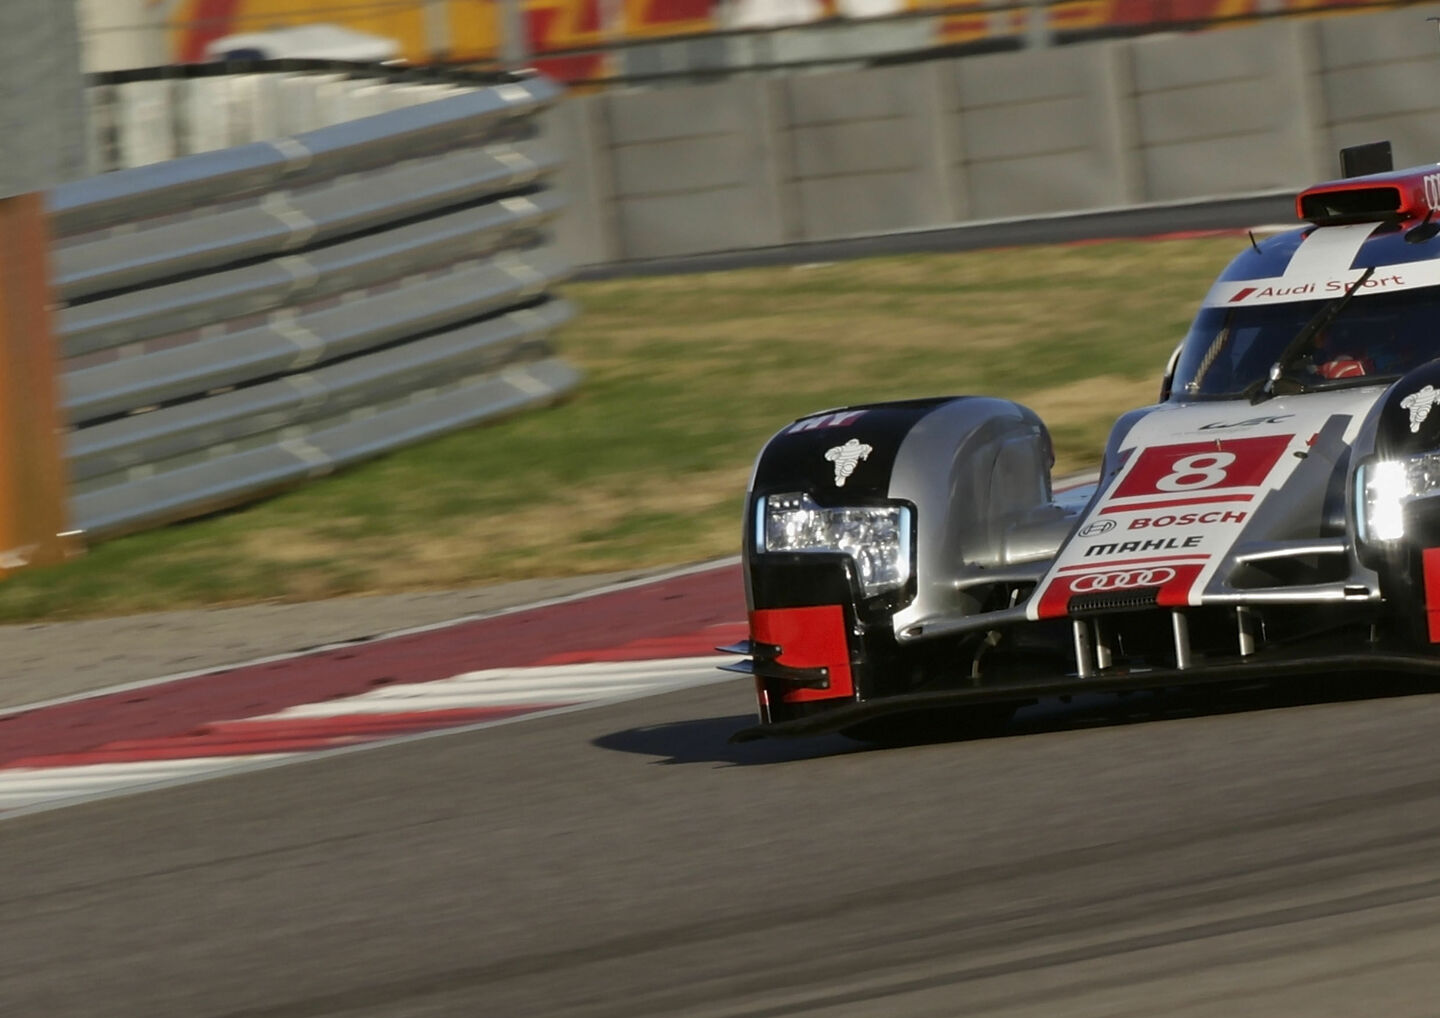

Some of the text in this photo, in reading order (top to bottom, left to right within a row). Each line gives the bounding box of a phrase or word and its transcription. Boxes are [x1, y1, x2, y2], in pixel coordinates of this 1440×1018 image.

[1256, 275, 1405, 298] Audi Sport
[1156, 452, 1236, 492] 8
[1127, 511, 1248, 530] BOSCH
[1084, 536, 1203, 557] MAHLE
